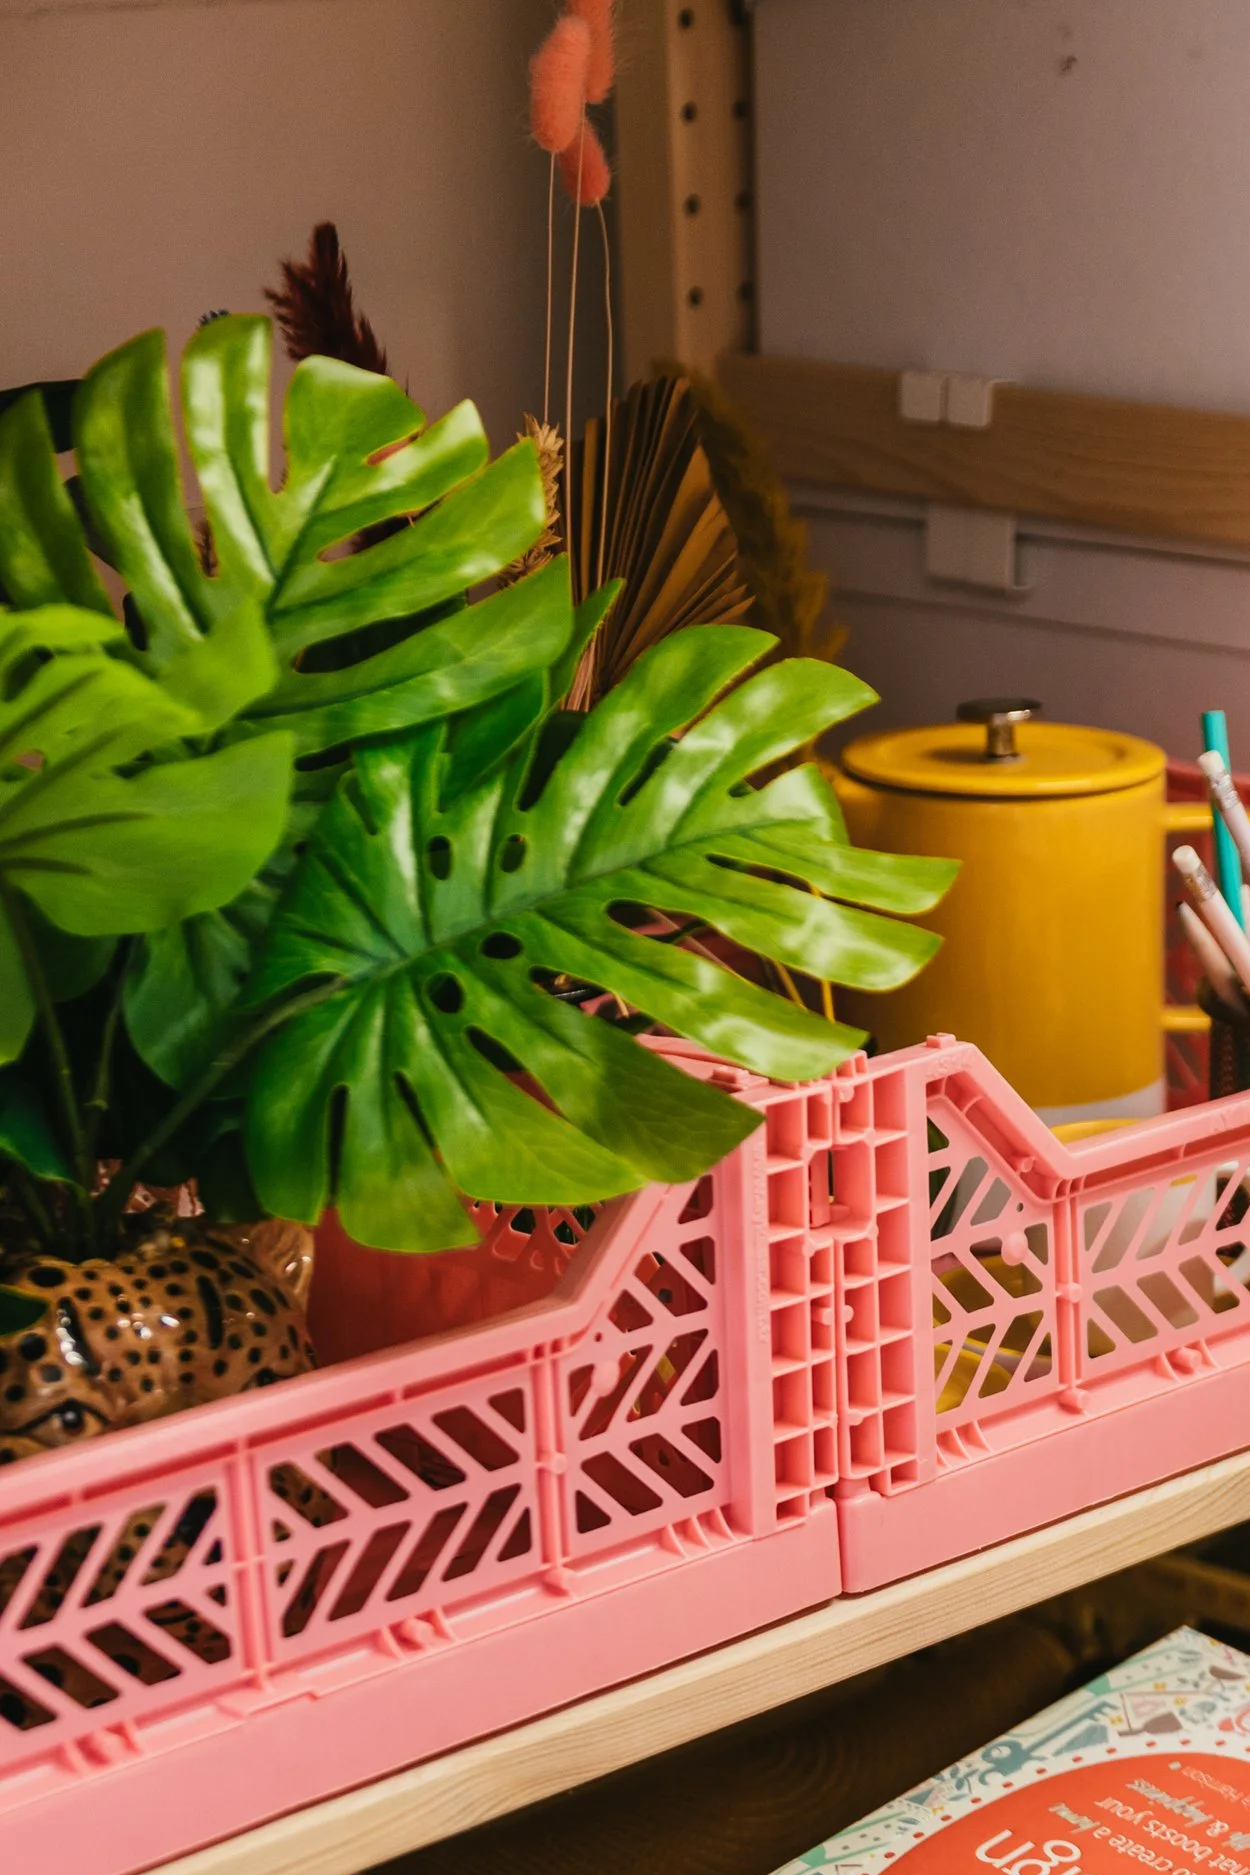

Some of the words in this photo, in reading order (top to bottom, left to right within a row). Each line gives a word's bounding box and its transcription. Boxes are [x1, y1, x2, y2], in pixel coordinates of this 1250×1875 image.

[1181, 1766, 1244, 1802] Harrison
[1094, 1797, 1153, 1826] your
[1093, 1827, 1111, 1839] a
[1143, 1819, 1213, 1863] boosts
[1206, 1820, 1229, 1837] &
[1108, 1834, 1173, 1872] create
